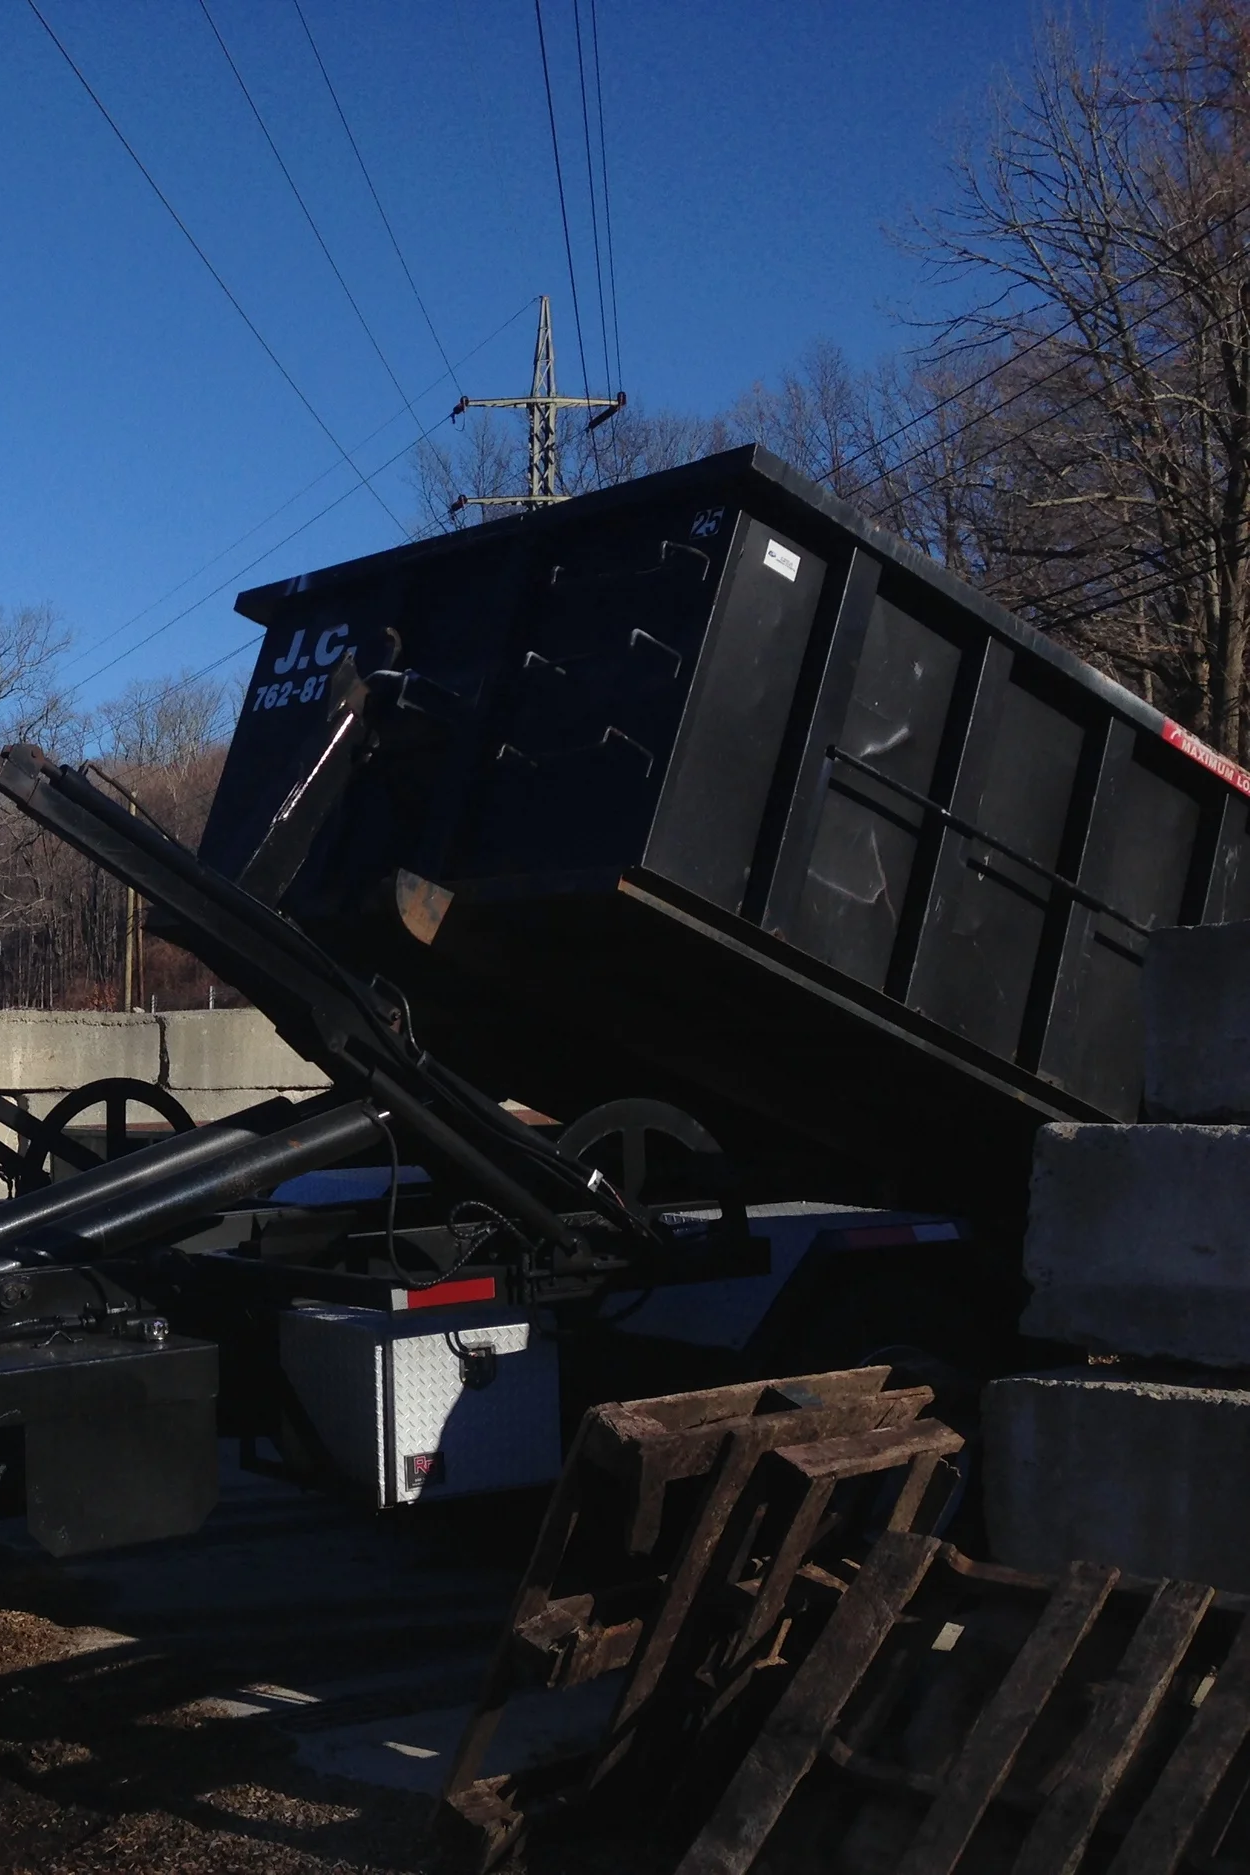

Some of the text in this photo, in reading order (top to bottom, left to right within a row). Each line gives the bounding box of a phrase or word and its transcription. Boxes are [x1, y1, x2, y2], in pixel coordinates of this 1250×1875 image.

[252, 674, 329, 712] 762-87
[1181, 739, 1250, 795] MAXIMUM LO
